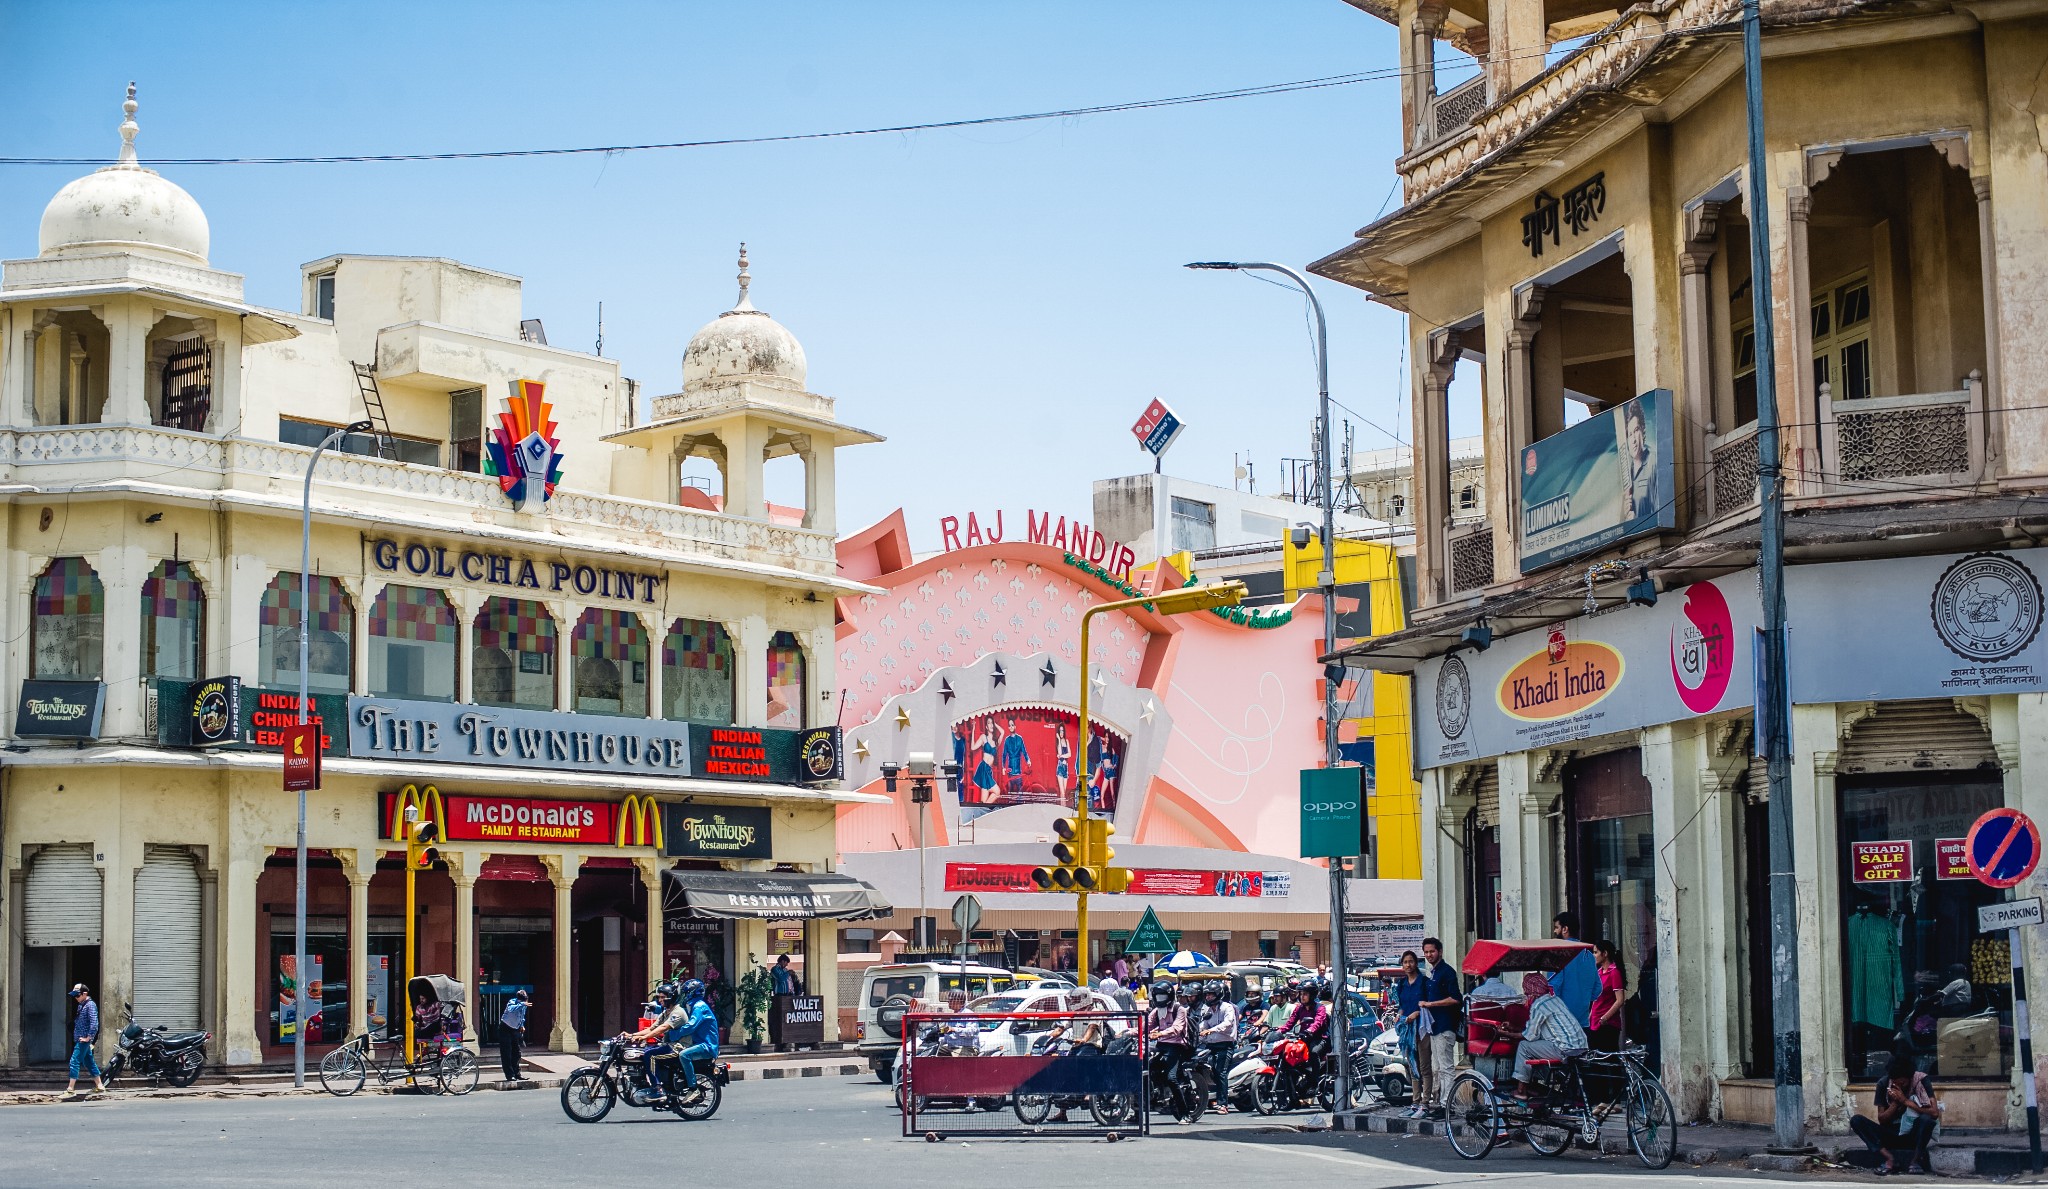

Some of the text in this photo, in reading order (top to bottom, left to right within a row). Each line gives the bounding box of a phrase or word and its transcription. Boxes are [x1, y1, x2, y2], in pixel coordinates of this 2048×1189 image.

[1520, 171, 1605, 258] मणि महल
[1147, 416, 1172, 447] Domino's
[1151, 433, 1168, 452] Pizza
[1526, 496, 1569, 534] LUMINOUS
[941, 509, 1135, 582] RAJ MANDIR
[373, 540, 660, 603] GOLCHA POINT
[1969, 638, 2008, 650] KVIC
[1950, 666, 1977, 677] कामये
[1513, 670, 1559, 710] Khadi
[1564, 660, 1606, 698] India
[192, 682, 225, 717] RESTAURANT
[245, 729, 332, 749] LEBE
[460, 712, 685, 768] TOWNHOUSE
[712, 729, 762, 744] INDIAN
[709, 745, 765, 760] ITALIAN
[801, 731, 830, 759] RESTAURANT
[288, 757, 309, 766] KALYAN
[705, 761, 770, 776] MEXICAN
[466, 802, 594, 826] McDonald's
[481, 824, 581, 838] FAMILY RESTAURANT
[699, 840, 740, 850] Restaurant
[1859, 845, 1905, 854] KHADI
[1941, 844, 1960, 853] खादी
[1860, 853, 1904, 864] SALE
[1872, 862, 1892, 870] WITH
[957, 870, 1022, 887] HOUSEFULL
[1864, 869, 1901, 880] GIFT
[728, 893, 832, 907] RESTAURANT
[757, 908, 815, 918] MULTI CUISINE
[1998, 906, 2039, 921] PARKING
[793, 999, 819, 1011] VALET
[786, 1010, 823, 1024] PARKING
